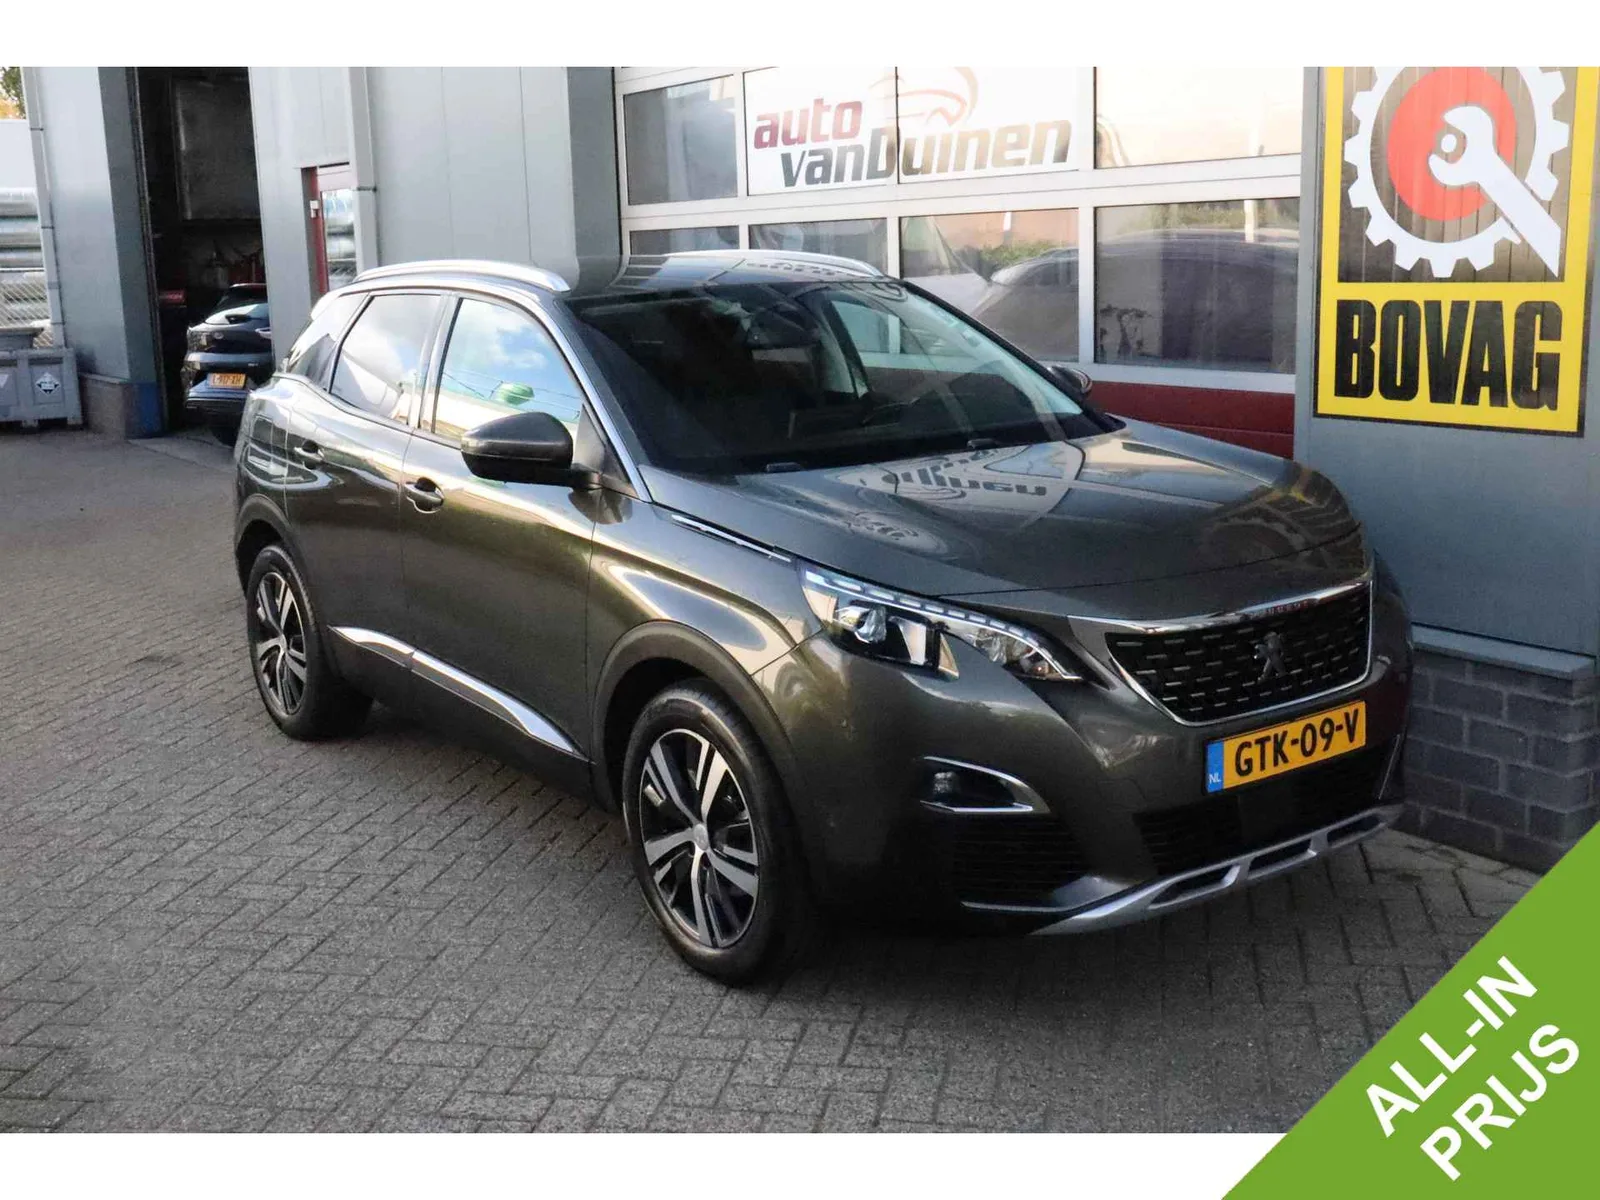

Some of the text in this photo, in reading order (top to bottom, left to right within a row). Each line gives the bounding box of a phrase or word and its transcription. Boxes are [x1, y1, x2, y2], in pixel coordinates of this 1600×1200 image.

[753, 98, 863, 150] auto
[1334, 299, 1563, 411] BOVAG
[1235, 708, 1359, 777] GTK-09-V
[1208, 772, 1222, 785] NL
